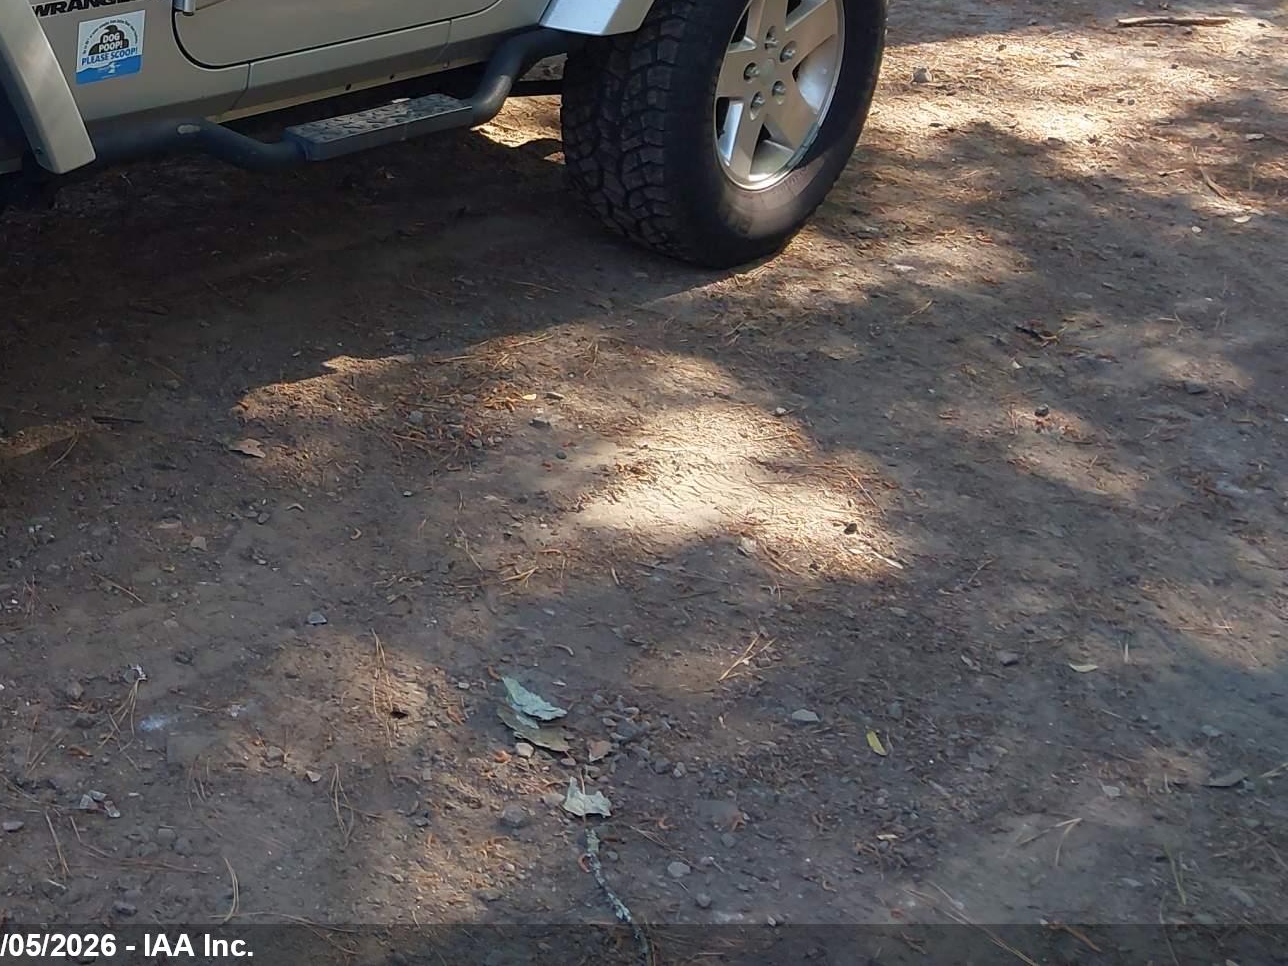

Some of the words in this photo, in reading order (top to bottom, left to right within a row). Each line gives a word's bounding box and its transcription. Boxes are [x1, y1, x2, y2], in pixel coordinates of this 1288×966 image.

[103, 32, 120, 44] DOG
[98, 40, 124, 53] POOP!
[81, 52, 110, 66] PLEASE
[110, 47, 138, 61] SCOOP!
